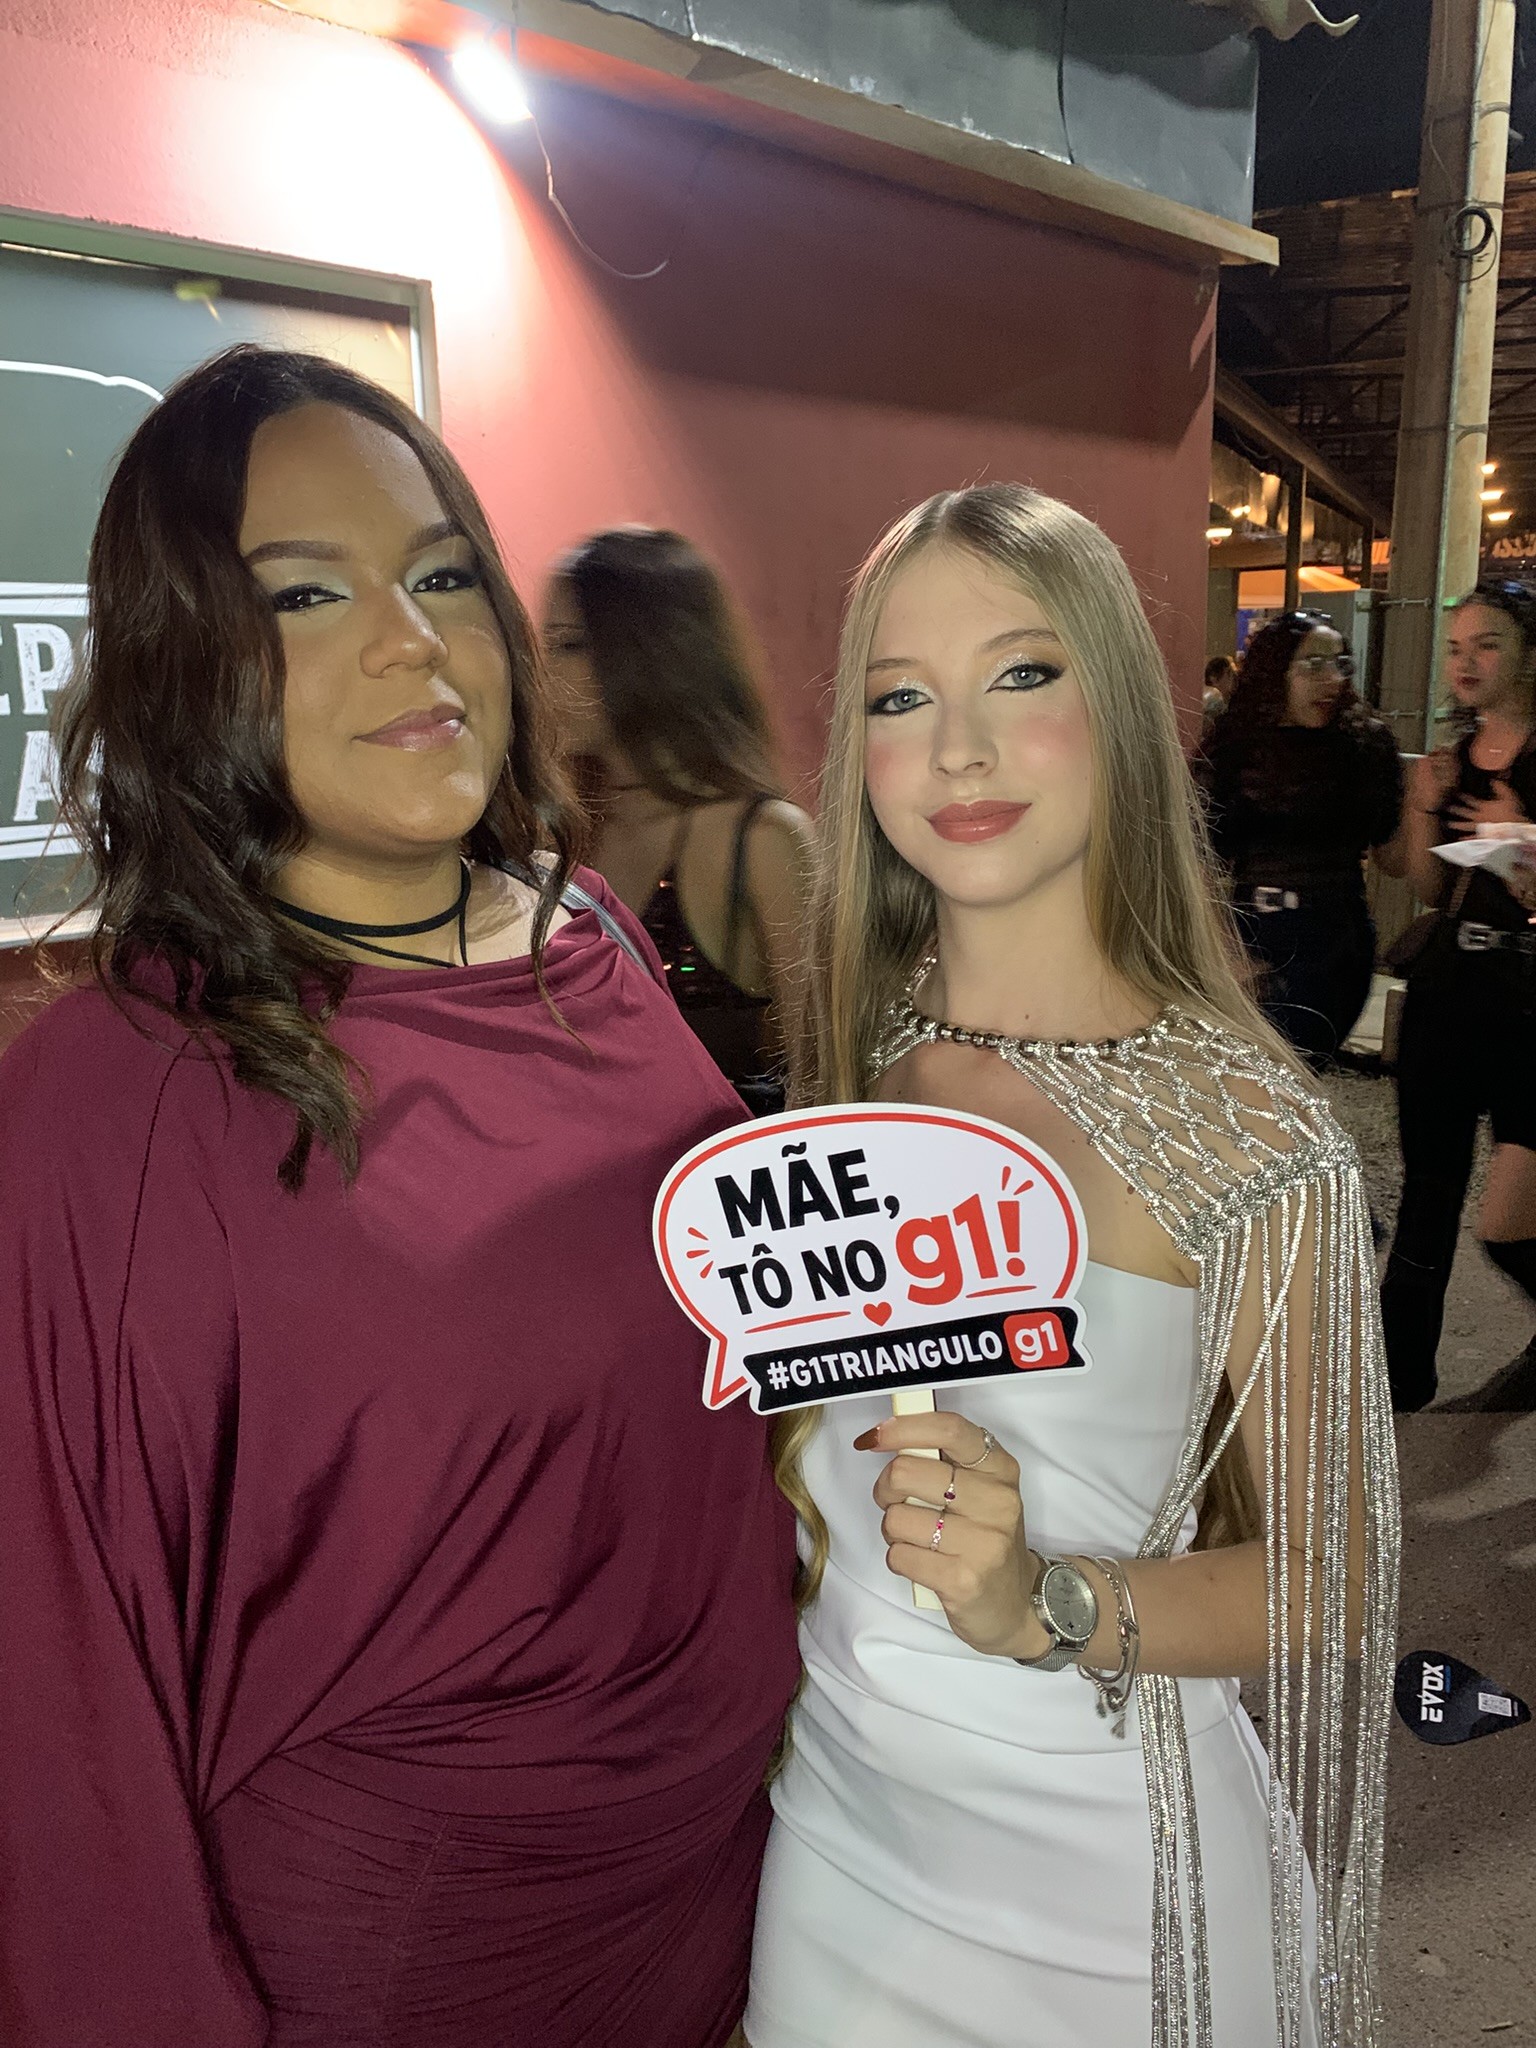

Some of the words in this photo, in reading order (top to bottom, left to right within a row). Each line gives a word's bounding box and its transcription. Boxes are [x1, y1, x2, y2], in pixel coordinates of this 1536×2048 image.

[715, 1142, 900, 1239] MÃE,
[718, 1243, 793, 1315] TÔ
[801, 1239, 888, 1301] NO
[895, 1193, 1026, 1306] g1!
[767, 1330, 1003, 1390] #G1TRIANGULO
[1014, 1321, 1060, 1362] g1
[1418, 1661, 1444, 1723] EVOX
